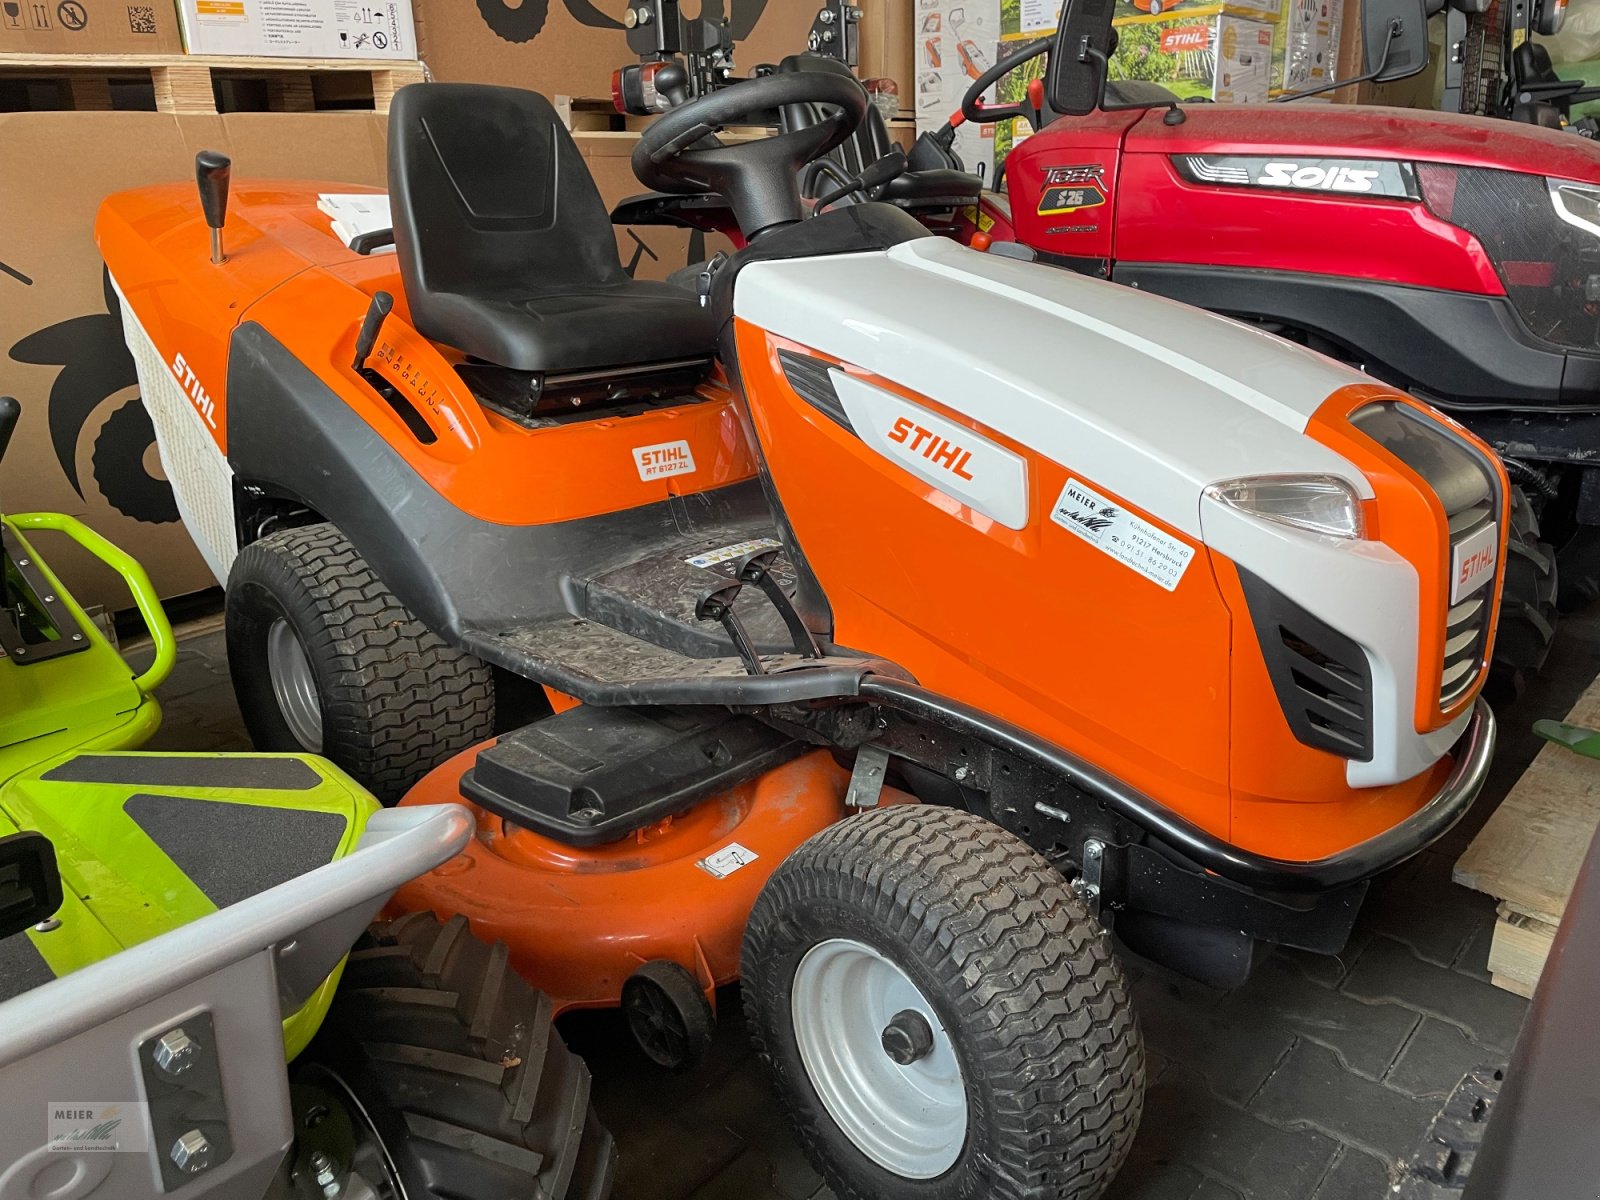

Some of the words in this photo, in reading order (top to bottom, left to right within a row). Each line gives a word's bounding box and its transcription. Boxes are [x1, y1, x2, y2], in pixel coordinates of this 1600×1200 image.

[1165, 32, 1203, 46] STIHL
[1040, 164, 1109, 193] TIGER
[172, 351, 217, 430] STIHL
[641, 446, 688, 466] STIHL
[887, 416, 974, 482] STIHL
[645, 466, 657, 476] RT
[658, 463, 677, 473] 6127
[1067, 488, 1096, 511] MEIER
[1131, 534, 1152, 548] 91217
[1151, 546, 1183, 569] Hersbruck
[1460, 543, 1494, 585] STIHL
